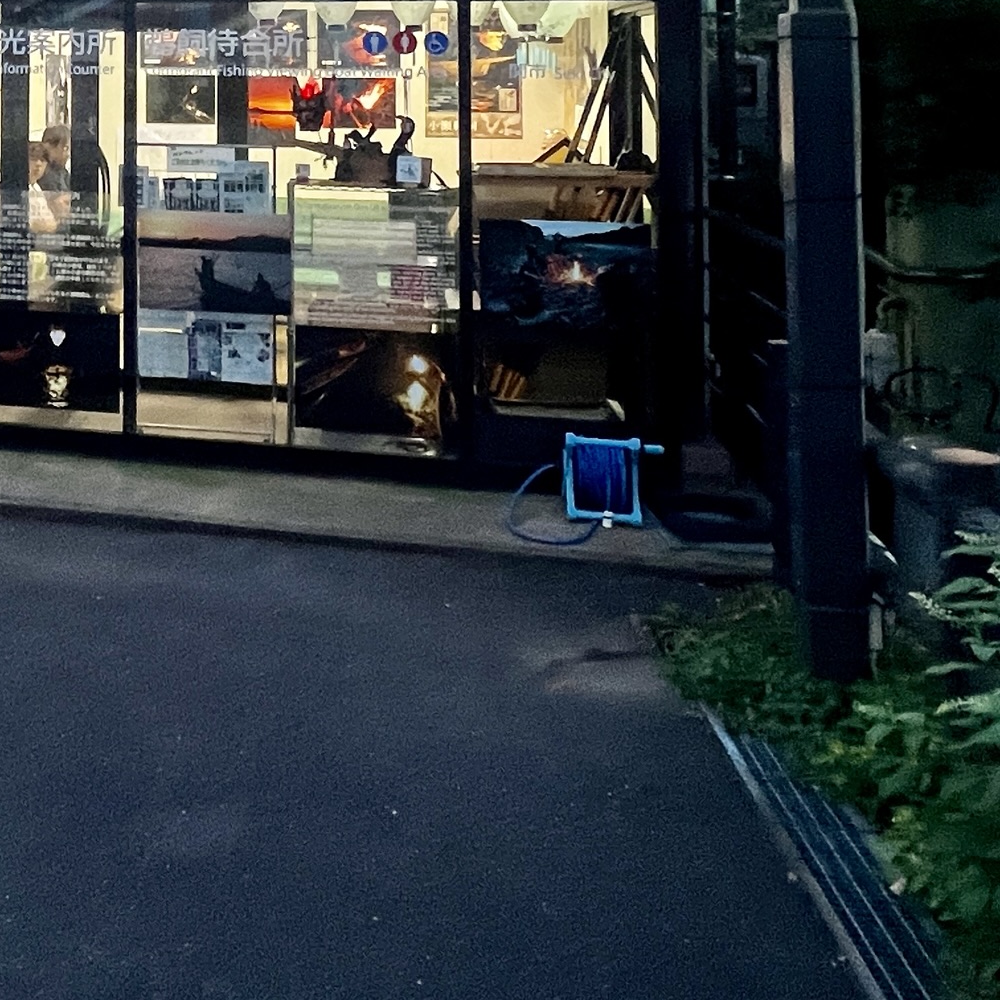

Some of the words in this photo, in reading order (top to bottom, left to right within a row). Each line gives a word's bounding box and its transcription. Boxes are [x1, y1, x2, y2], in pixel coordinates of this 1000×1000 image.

[145, 28, 305, 60] 鵜飼待合所
